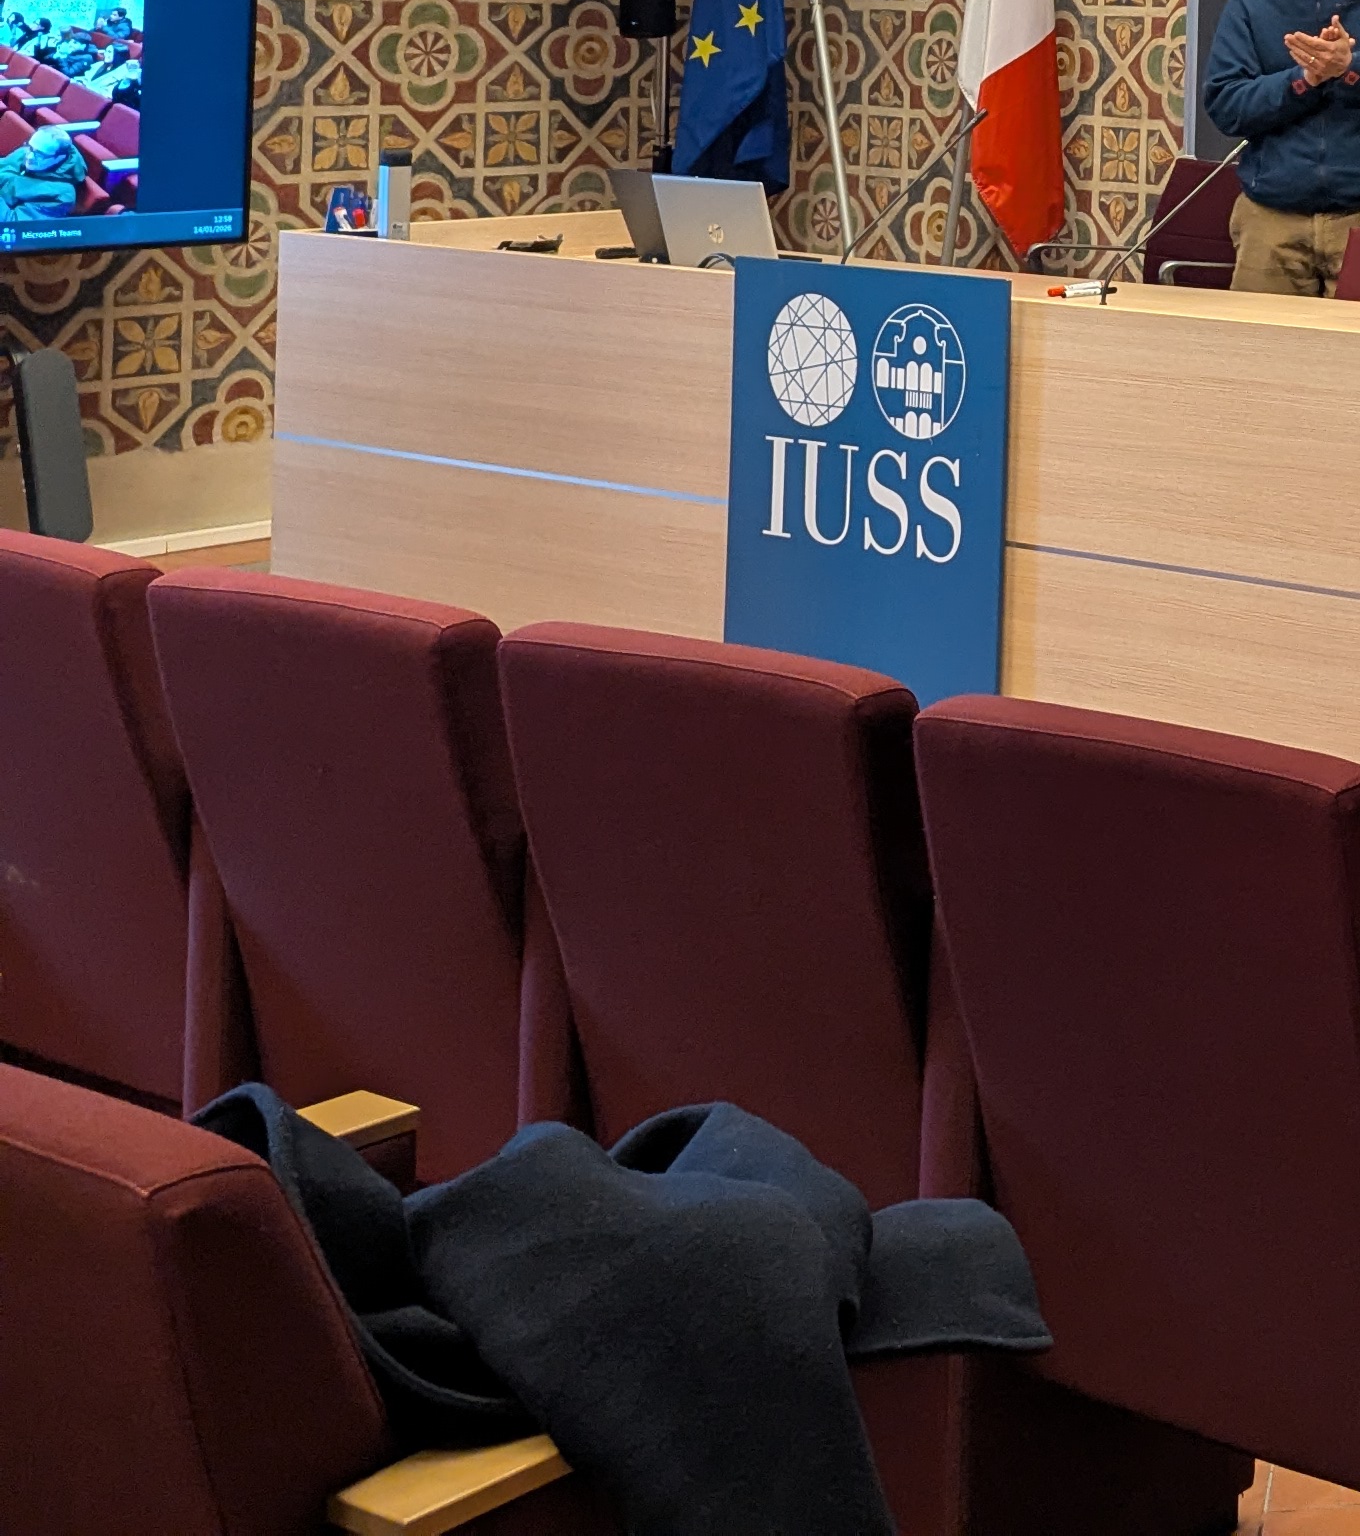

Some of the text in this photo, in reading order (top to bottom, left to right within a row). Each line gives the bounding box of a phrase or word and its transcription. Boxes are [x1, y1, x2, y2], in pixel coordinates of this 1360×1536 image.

[22, 229, 83, 240] Microsoft Teams
[762, 434, 962, 564] IUSS
